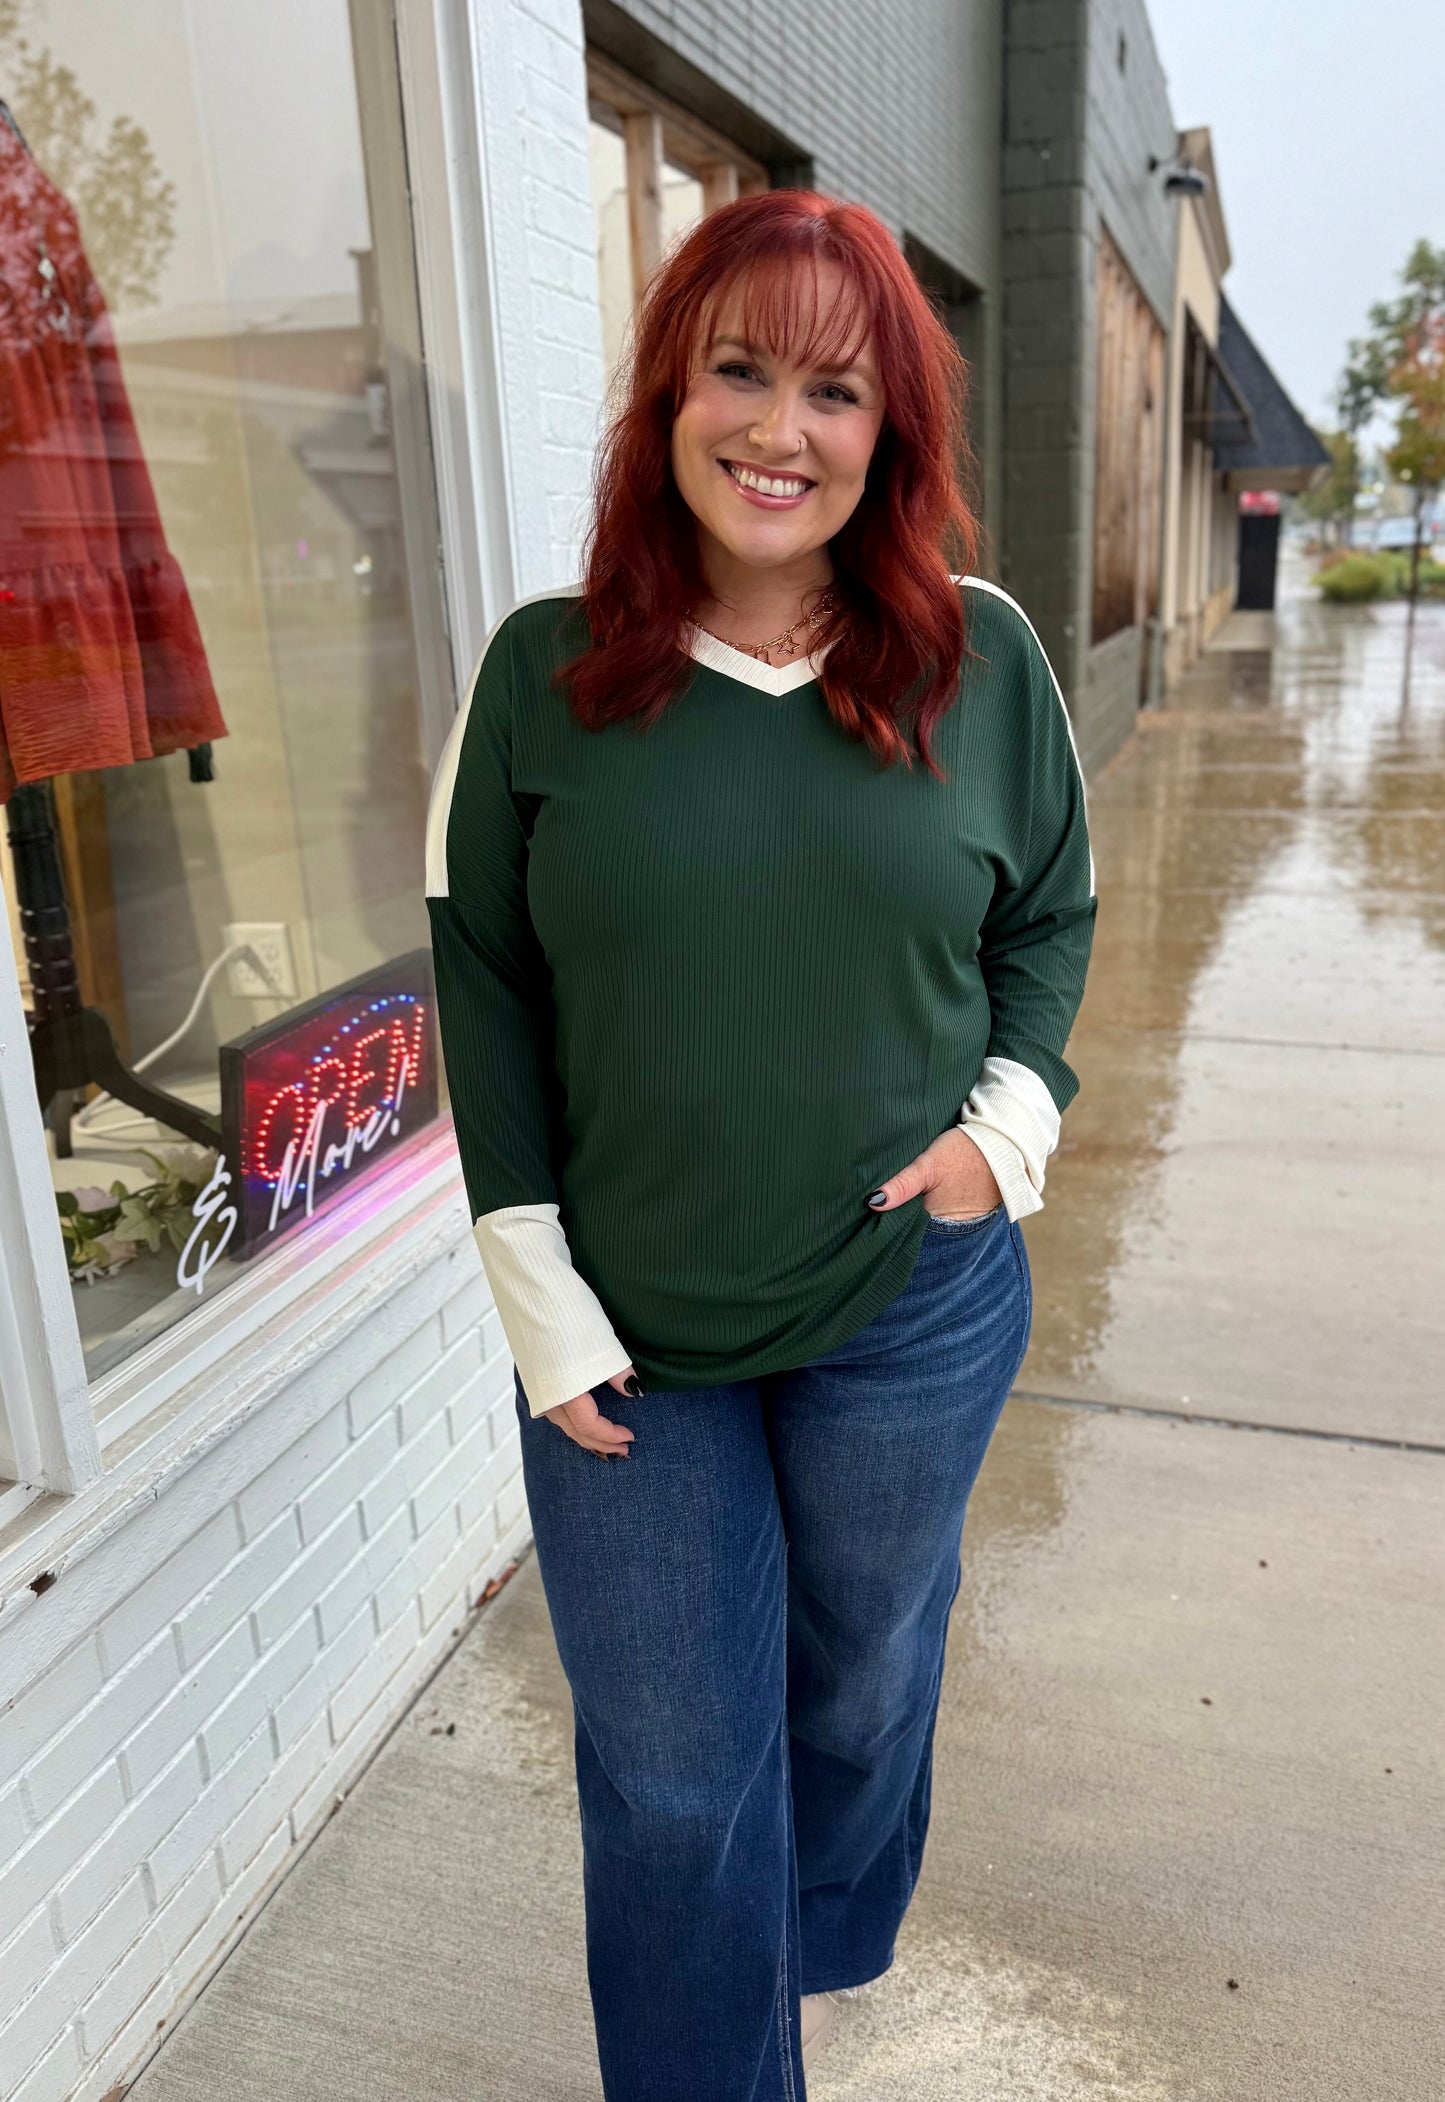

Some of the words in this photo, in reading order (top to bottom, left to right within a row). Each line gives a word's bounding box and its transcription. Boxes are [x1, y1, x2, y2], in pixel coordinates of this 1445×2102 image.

[177, 1155, 238, 1294] &
[268, 1053, 411, 1231] More!
[257, 1005, 424, 1179] OPEN
